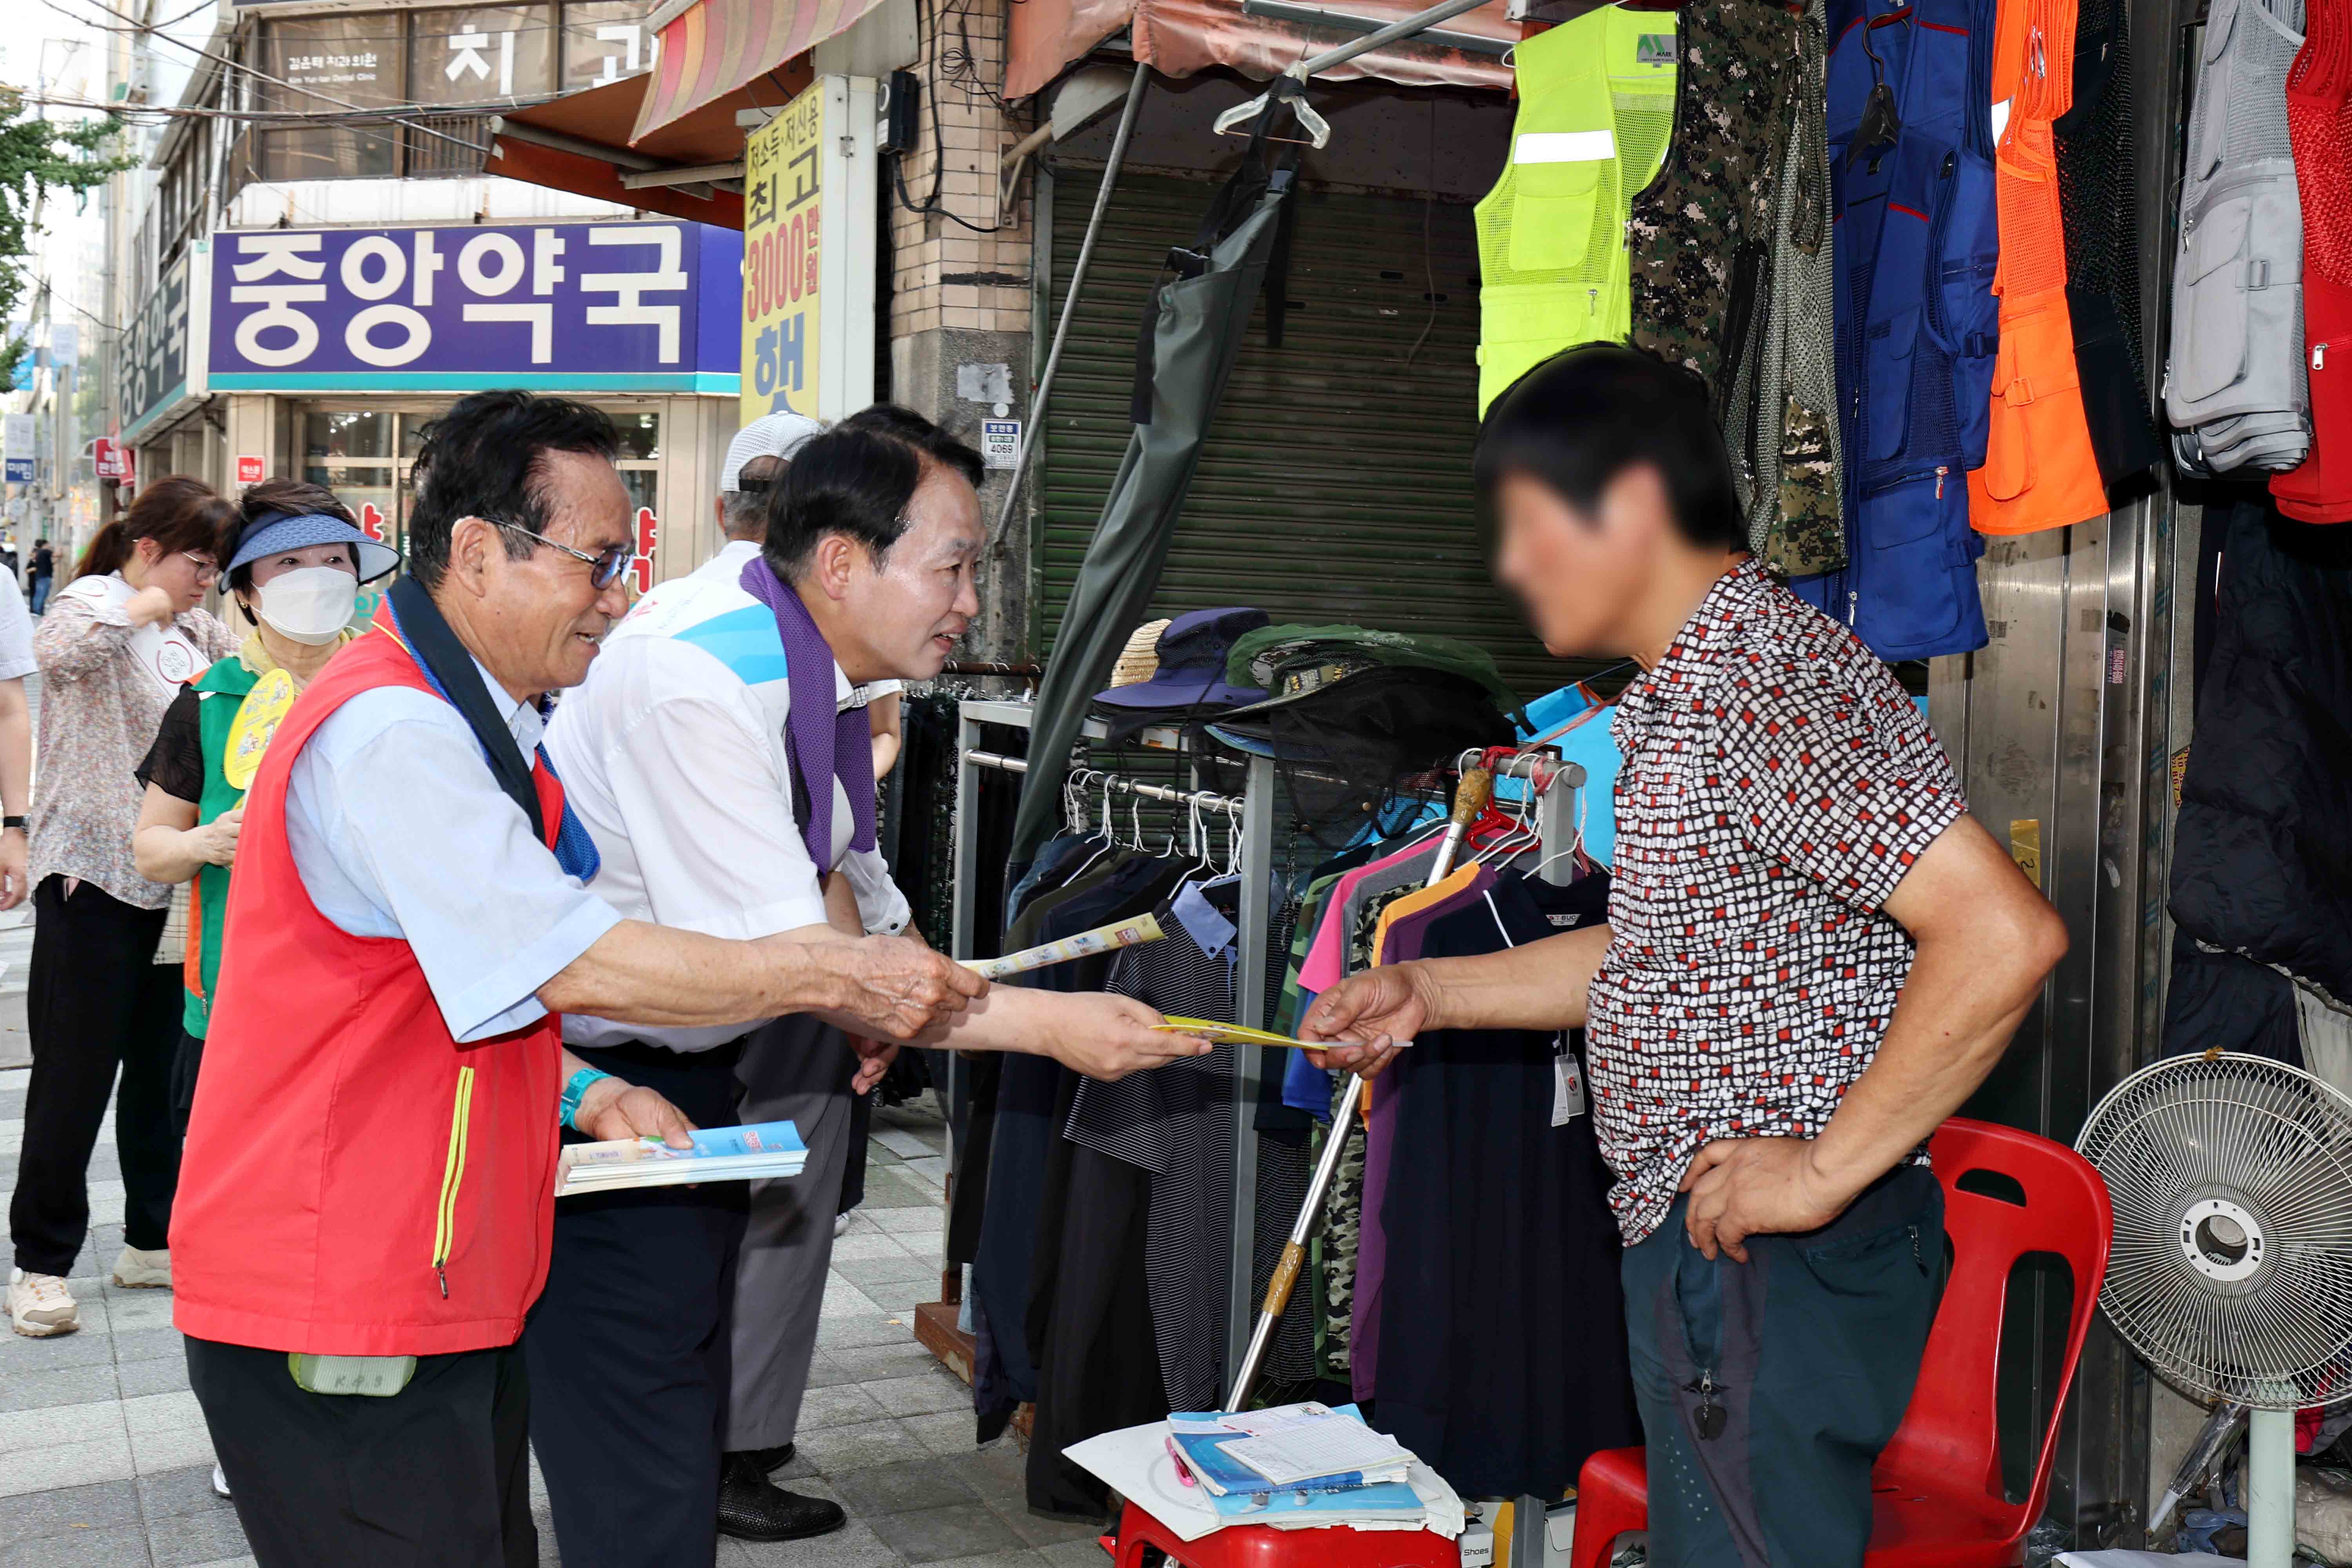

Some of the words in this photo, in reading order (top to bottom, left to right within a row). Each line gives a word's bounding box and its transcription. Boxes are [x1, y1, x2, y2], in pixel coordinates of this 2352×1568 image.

[326, 53, 377, 67] 치과의원
[230, 225, 688, 368] 중앙약국
[747, 213, 803, 322] 3000
[120, 258, 189, 426] 중앙약국
[991, 444, 1013, 454] 4069
